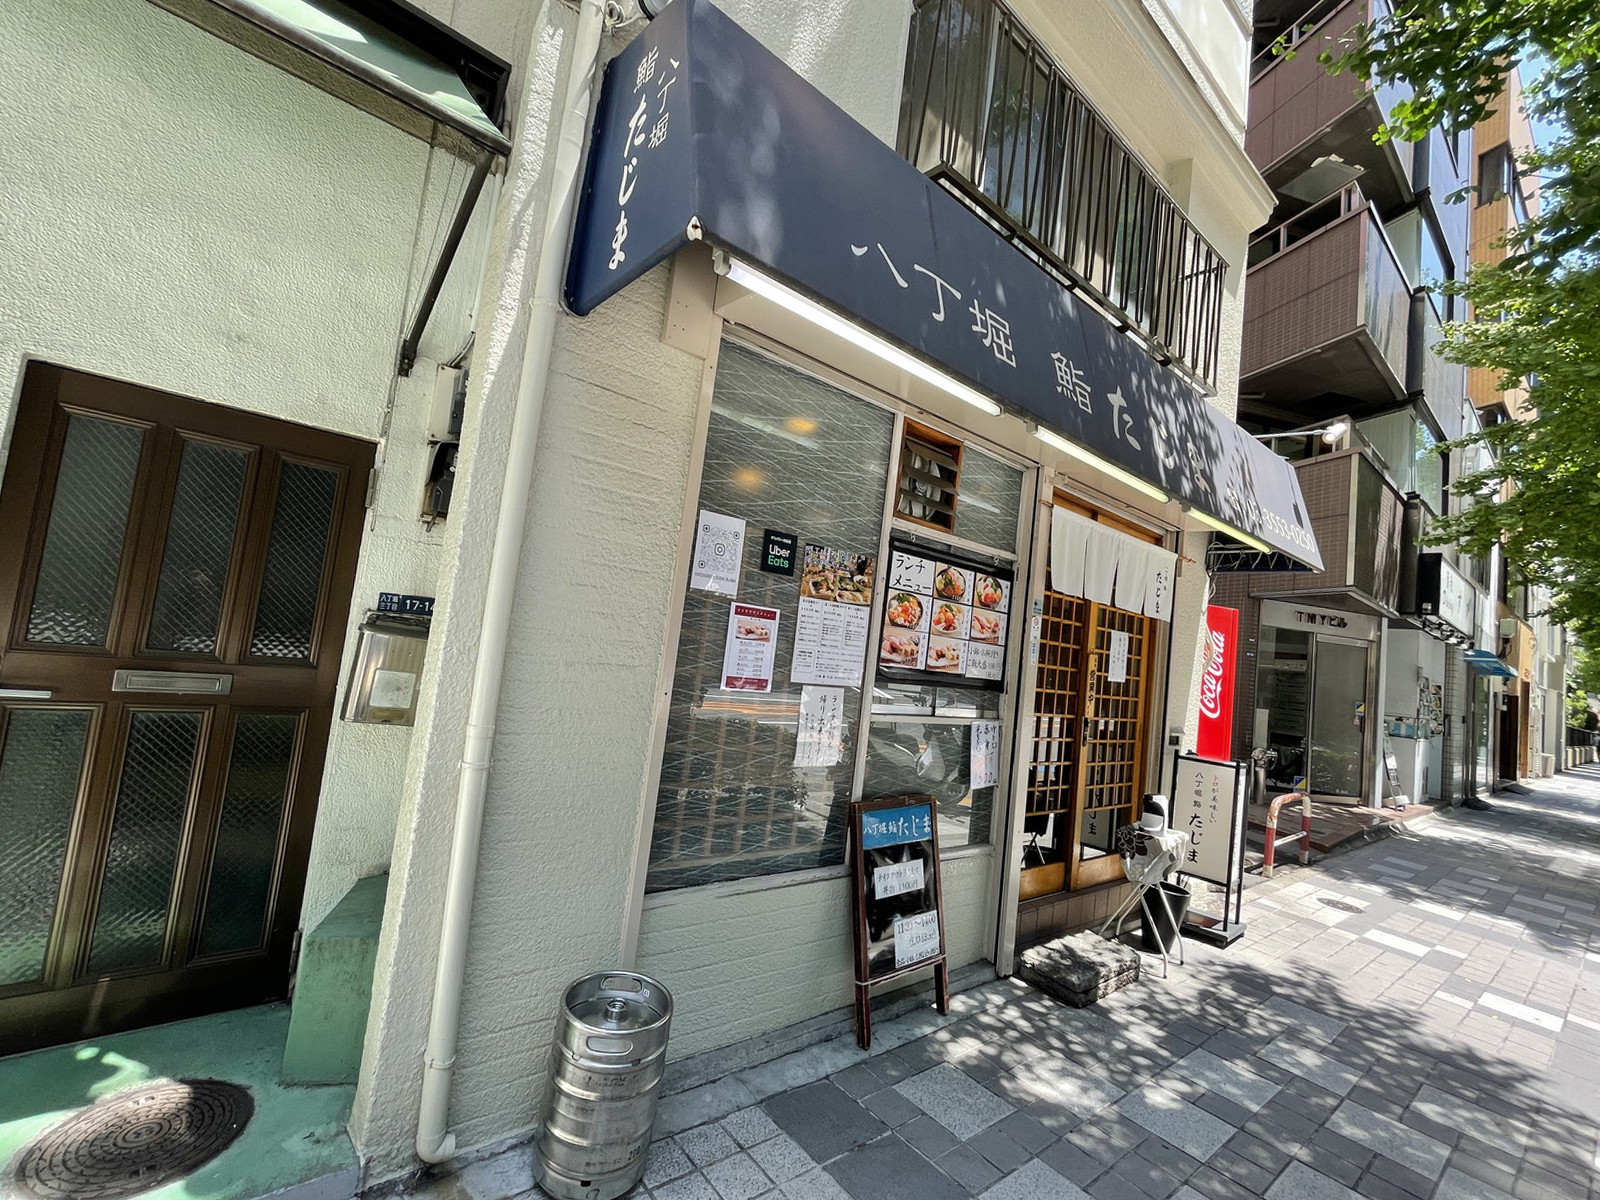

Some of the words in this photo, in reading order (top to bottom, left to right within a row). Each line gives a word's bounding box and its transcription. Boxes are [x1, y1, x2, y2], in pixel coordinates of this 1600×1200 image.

[648, 58, 679, 148] 八丁堀
[608, 46, 658, 270] 鮨たじま
[851, 243, 1017, 368] 八丁堀
[768, 555, 789, 568] Eats
[769, 544, 790, 557] Uber
[896, 554, 926, 574] ランチ
[893, 574, 932, 593] メニュー
[1209, 775, 1220, 824] トロが美味しい
